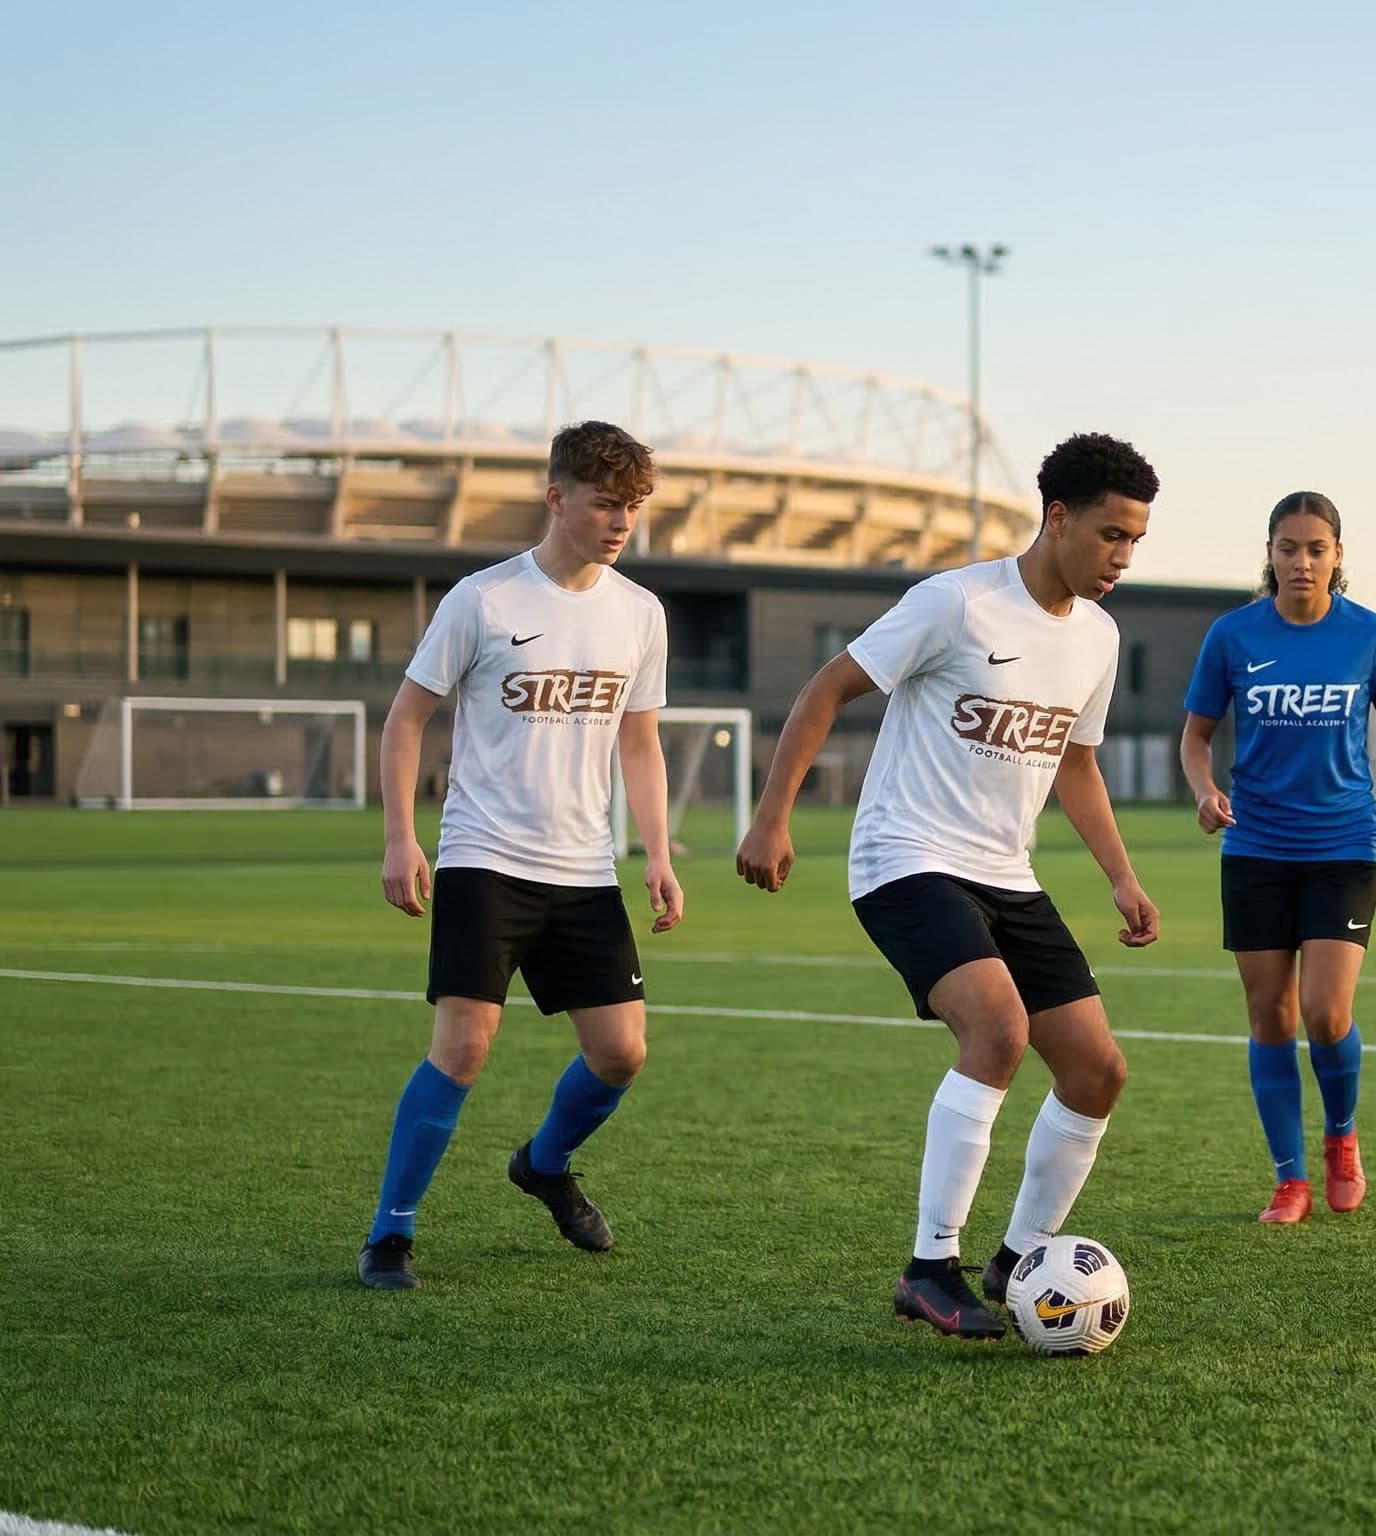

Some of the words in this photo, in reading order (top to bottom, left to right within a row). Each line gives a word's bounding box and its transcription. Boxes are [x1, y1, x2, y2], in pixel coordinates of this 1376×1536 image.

[503, 673, 630, 713] STREET
[1247, 683, 1361, 718] STREET
[522, 715, 569, 726] FOOTBALL
[953, 698, 1079, 757] STREET
[968, 744, 1023, 766] FOOTBALL
